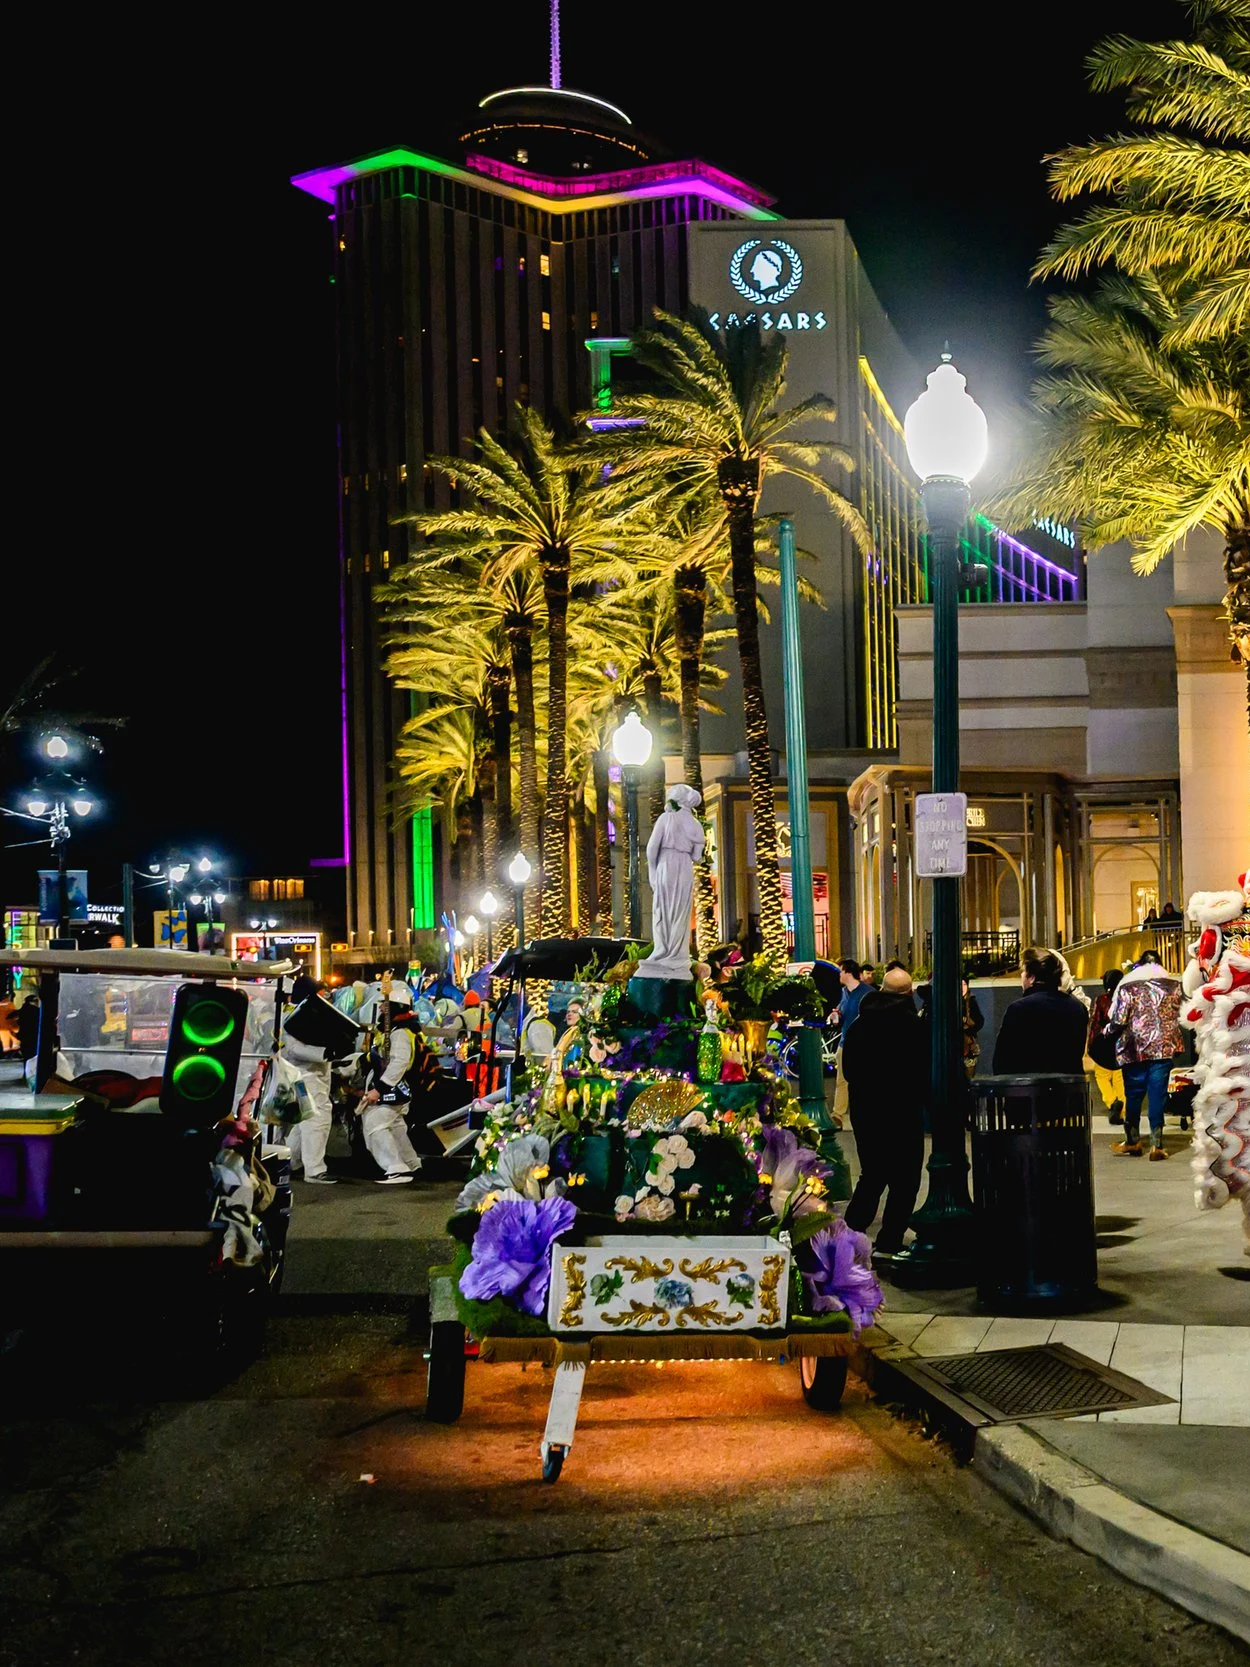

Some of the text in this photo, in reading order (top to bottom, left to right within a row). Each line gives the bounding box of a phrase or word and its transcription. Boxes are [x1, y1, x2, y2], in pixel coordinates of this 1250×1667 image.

[933, 801, 948, 813] NO
[919, 818, 963, 833] STOPPING
[931, 839, 950, 852] ANY
[930, 857, 951, 869] TIME
[86, 903, 125, 912] COLLECTIO
[88, 912, 121, 925] RWALK
